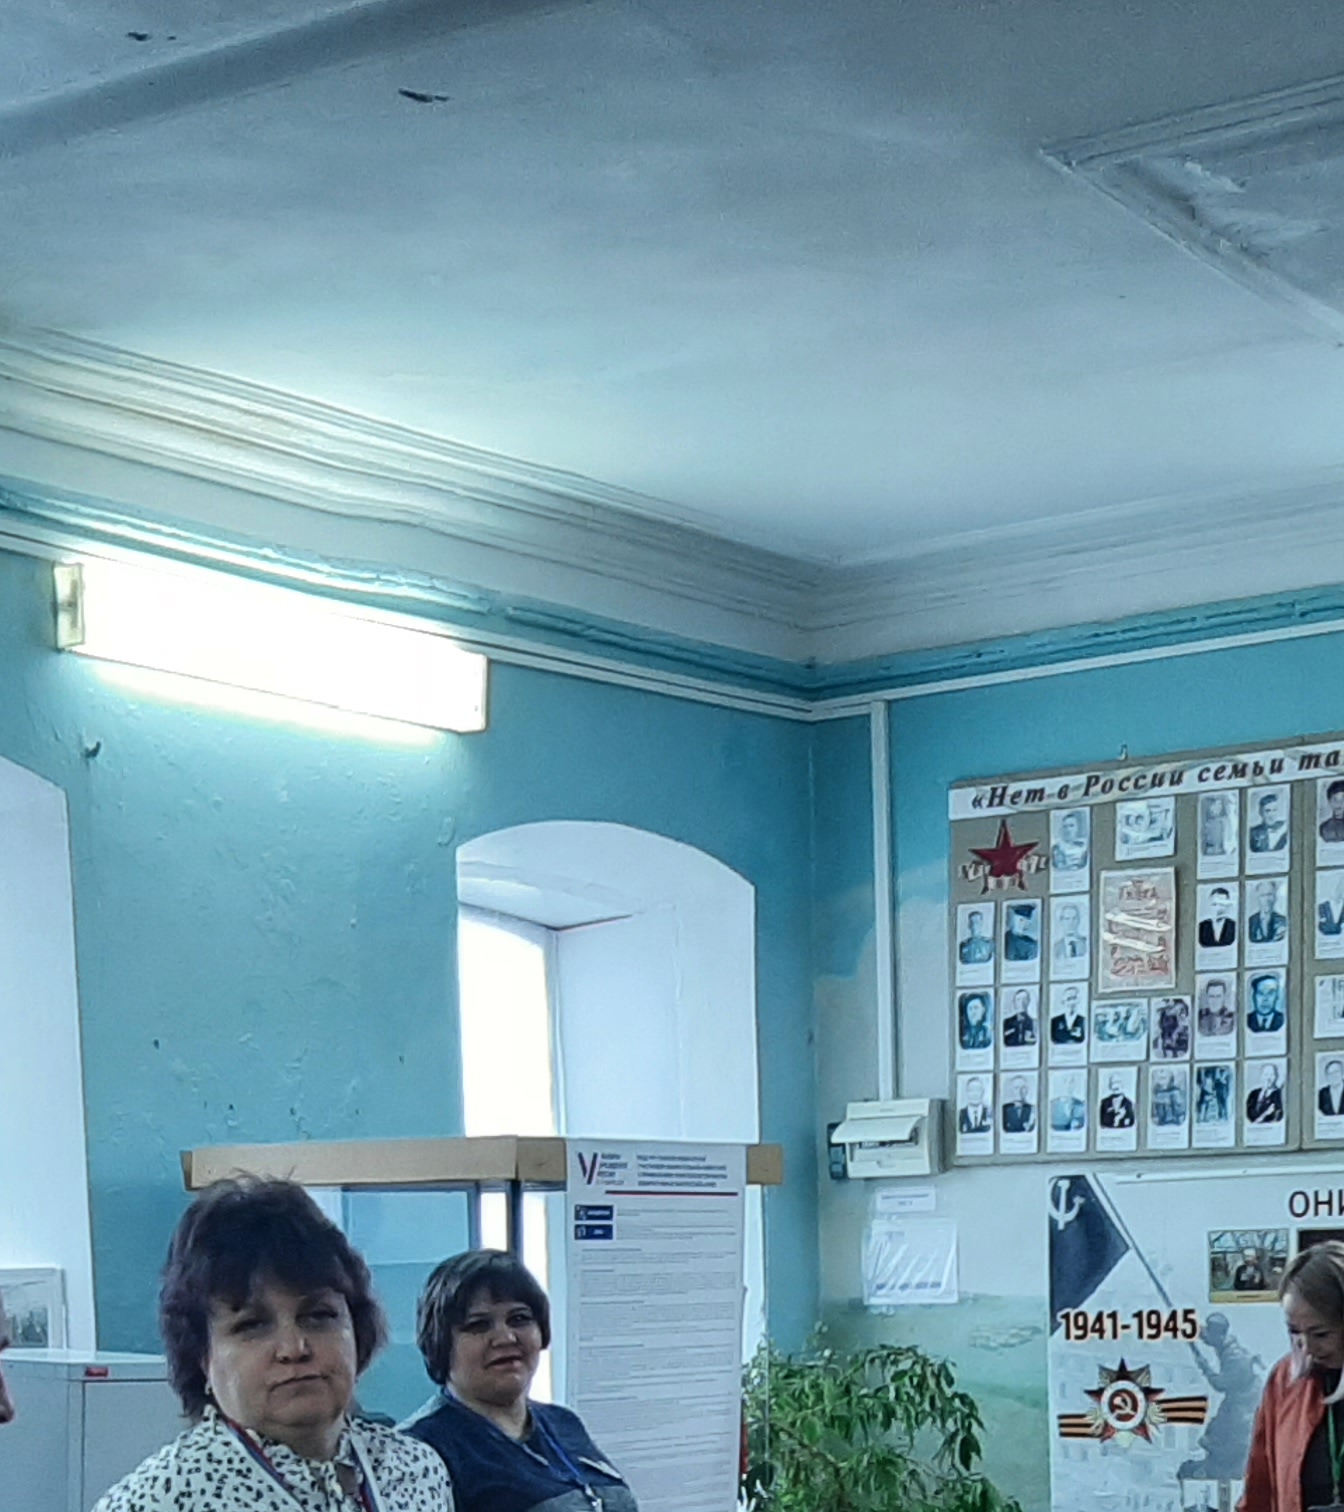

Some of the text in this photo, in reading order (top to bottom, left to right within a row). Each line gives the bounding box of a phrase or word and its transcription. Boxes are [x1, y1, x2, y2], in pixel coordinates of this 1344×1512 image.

[971, 786, 1045, 810] «Нет
[1057, 786, 1069, 801] в
[1083, 769, 1184, 799] России
[1196, 758, 1284, 784] семьи
[1059, 1308, 1199, 1341] 1941-1945
